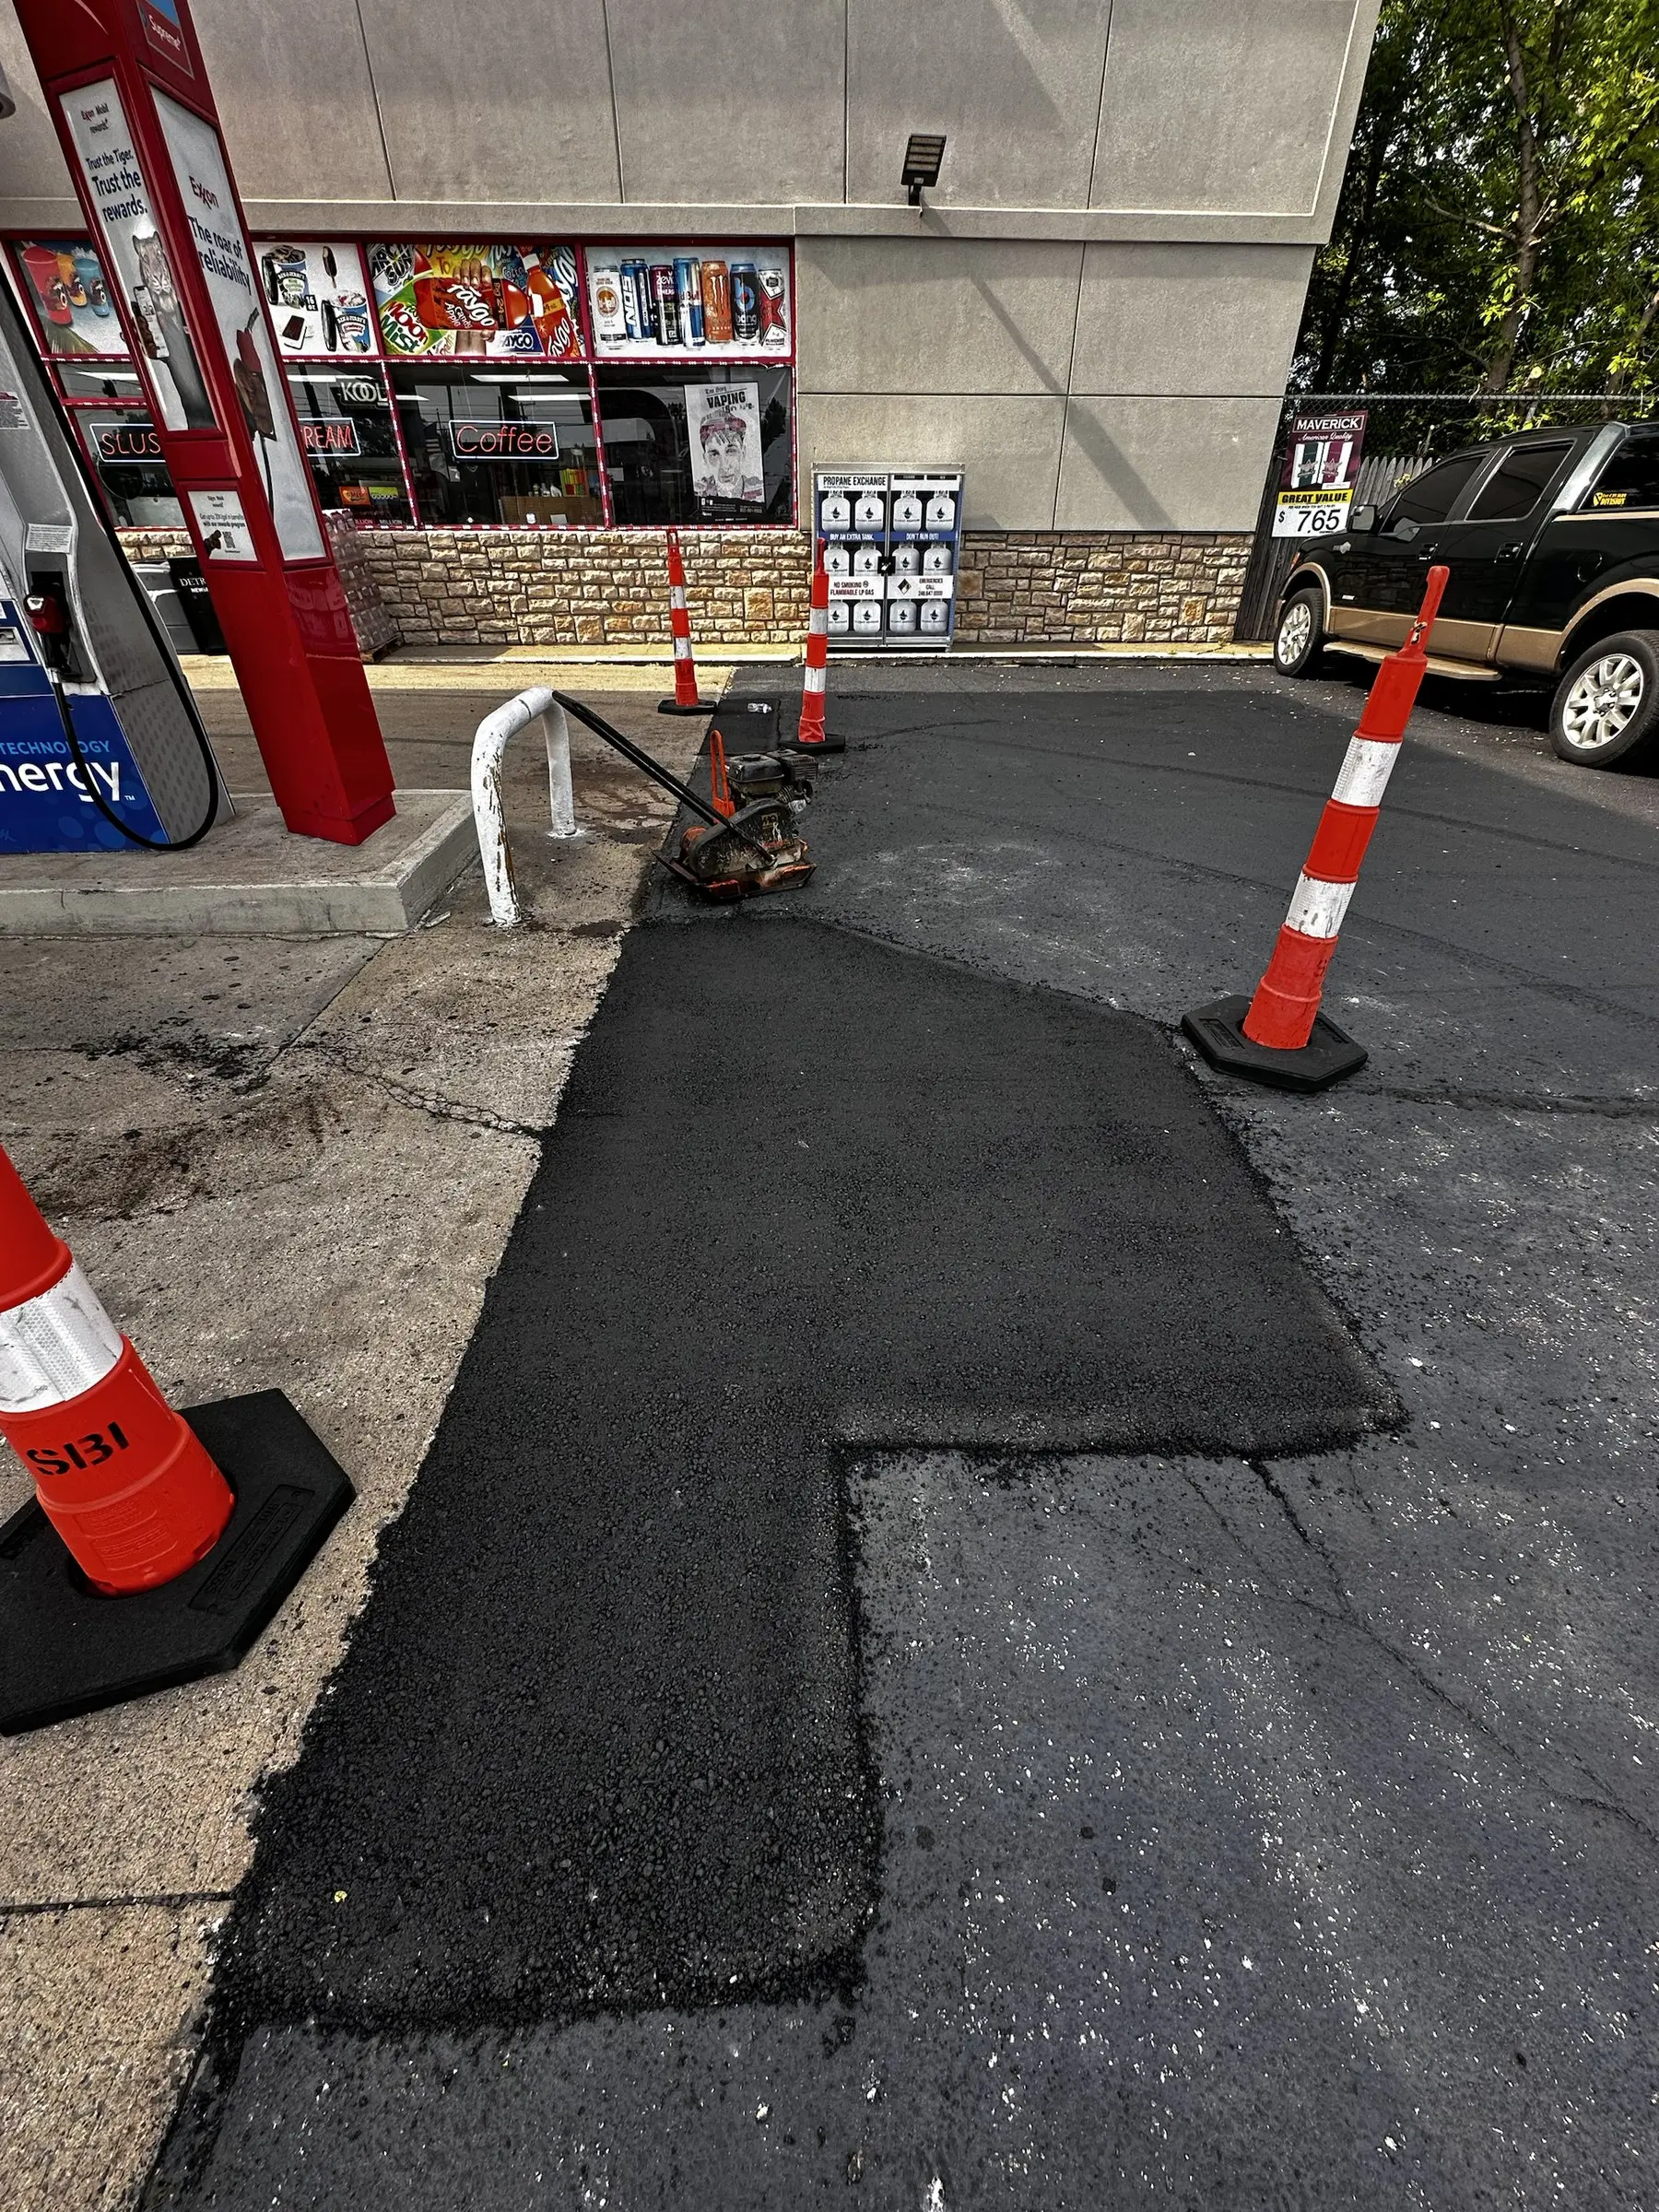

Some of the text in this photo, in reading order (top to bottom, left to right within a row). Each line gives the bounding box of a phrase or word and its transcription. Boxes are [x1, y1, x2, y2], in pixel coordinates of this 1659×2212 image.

[85, 148, 134, 170] Trust the Tiger.
[92, 167, 142, 196] Trust the
[189, 175, 219, 210] Exxon
[102, 194, 147, 222] rewards.
[187, 215, 243, 260] The roar of
[198, 248, 252, 296] reliability
[306, 296, 313, 306] 16
[340, 382, 387, 402] KOOL
[707, 392, 746, 408] VAPING
[1297, 418, 1359, 430] MAVERICK
[300, 425, 353, 448] REAM
[457, 425, 552, 453] Coffee
[1298, 431, 1353, 441] American Quality
[823, 477, 886, 486] PROPANE EXCHANGE
[1281, 493, 1347, 503] GREAT VALUE
[1278, 509, 1341, 533] $ 7.65
[0, 740, 110, 756] TECHNOOGY
[26, 1421, 130, 1477] SBI
